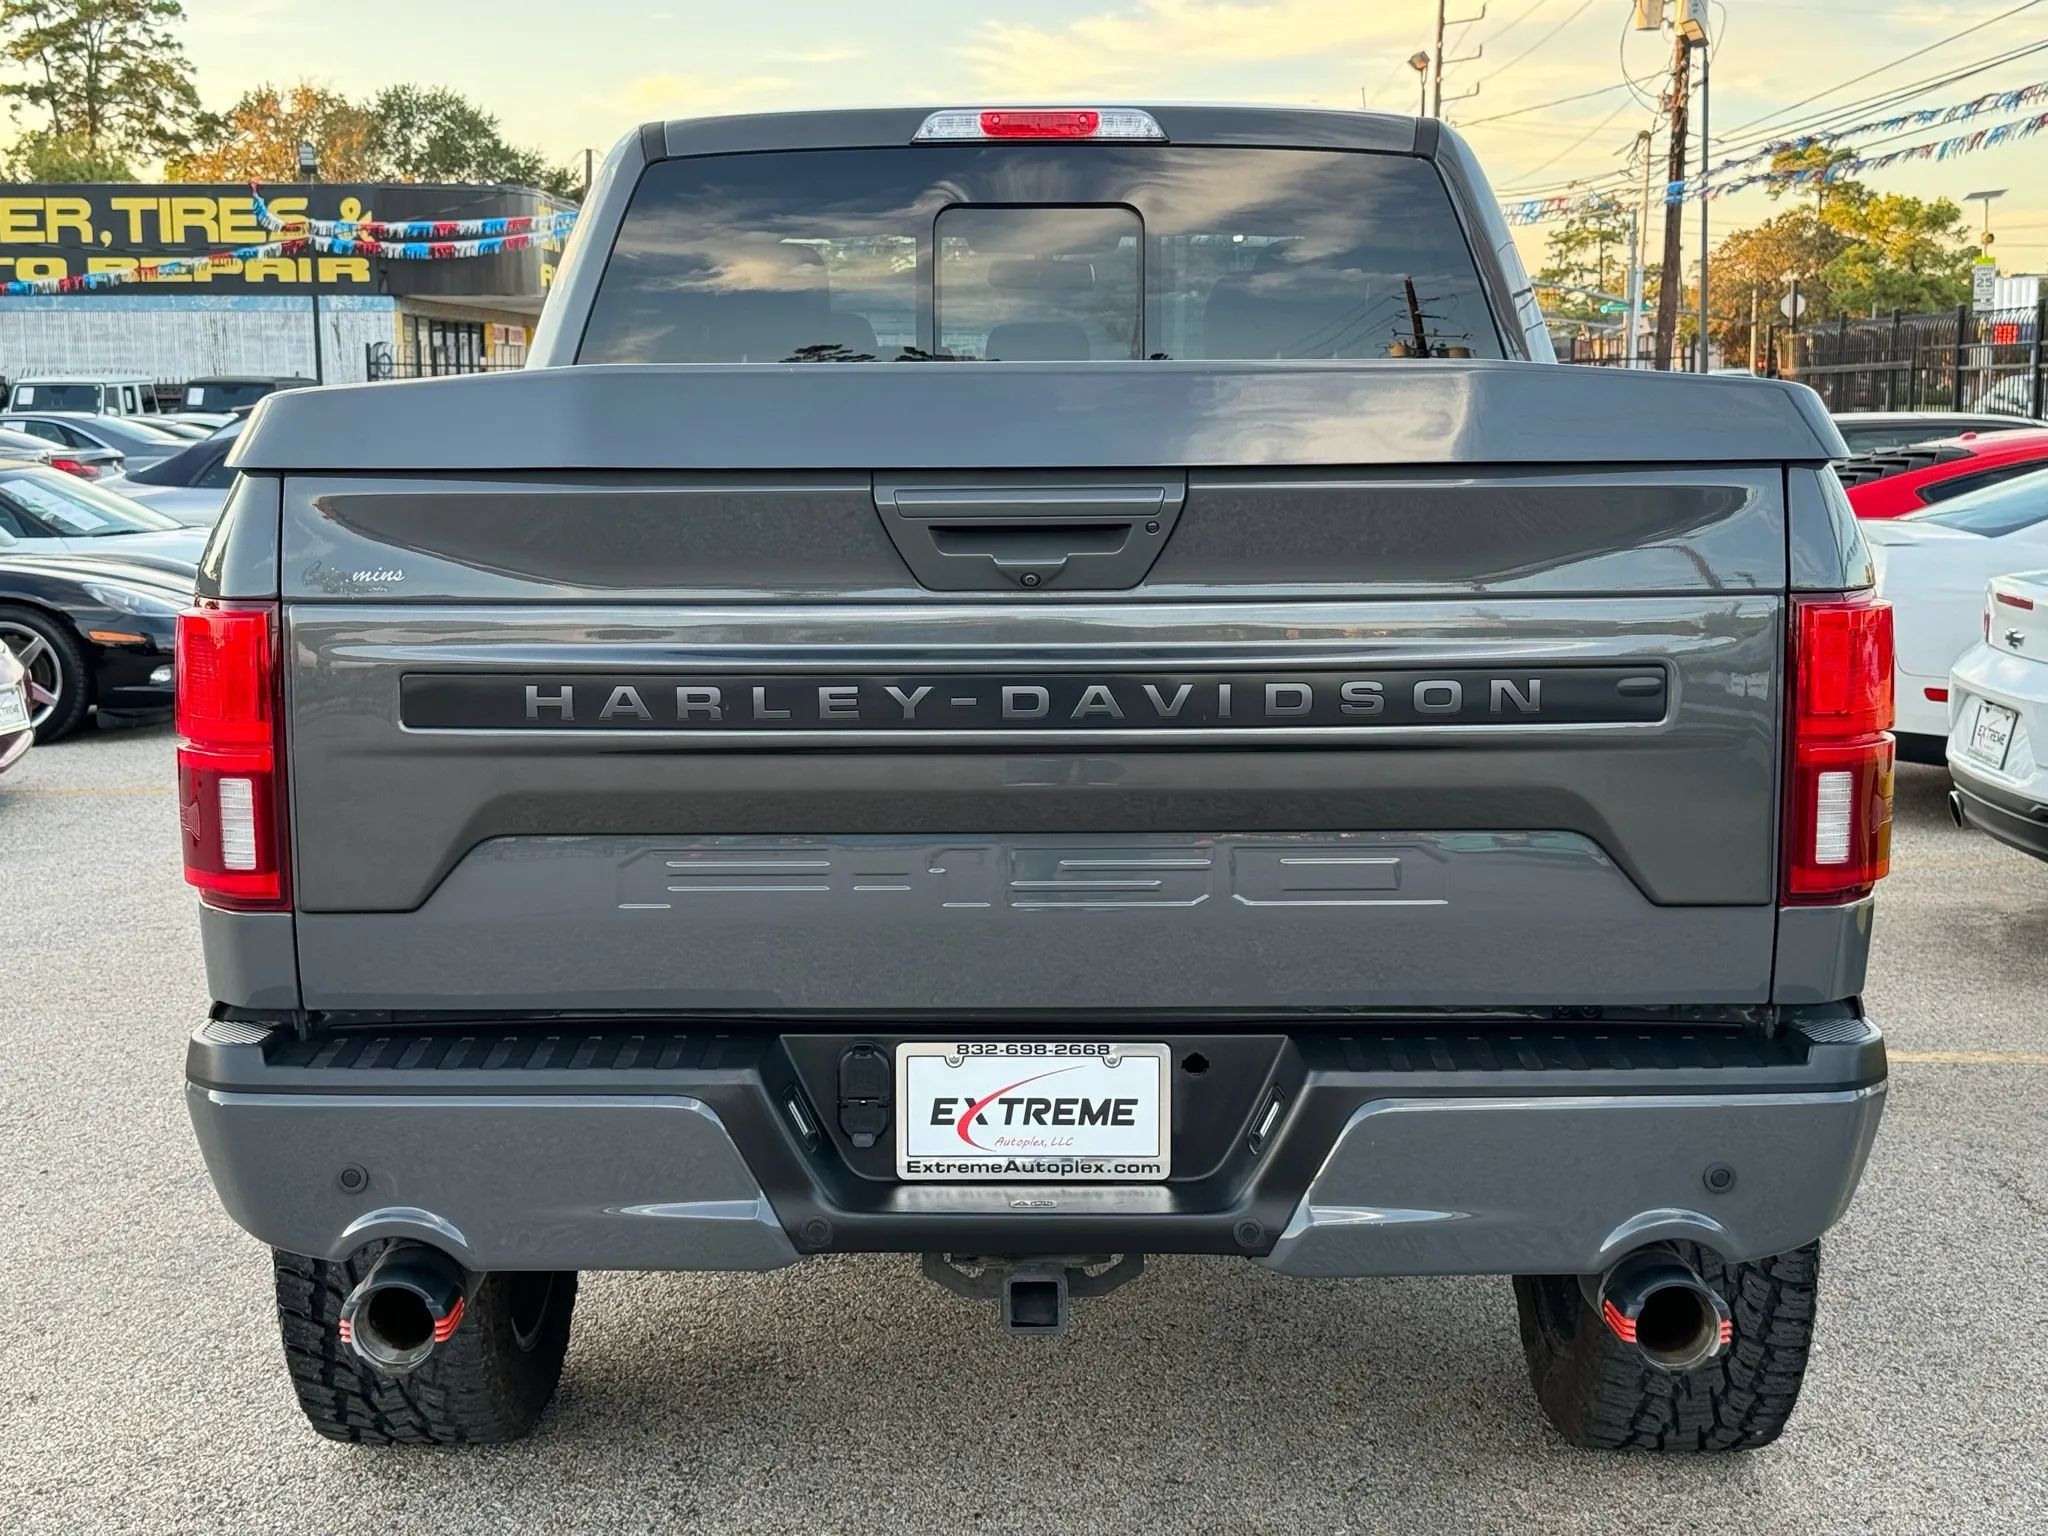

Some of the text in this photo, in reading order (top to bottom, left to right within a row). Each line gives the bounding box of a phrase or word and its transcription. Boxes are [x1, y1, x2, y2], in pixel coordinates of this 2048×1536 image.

[1976, 277, 1993, 288] 25
[525, 678, 1541, 721] HARLEY-DAVIDSON
[956, 1044, 1110, 1055] 832-698-2668
[930, 1097, 1138, 1126] EXTREME
[995, 1136, 1074, 1148] Autoplex, LLC
[907, 1160, 1161, 1176] ExtremeAutoplex.com
